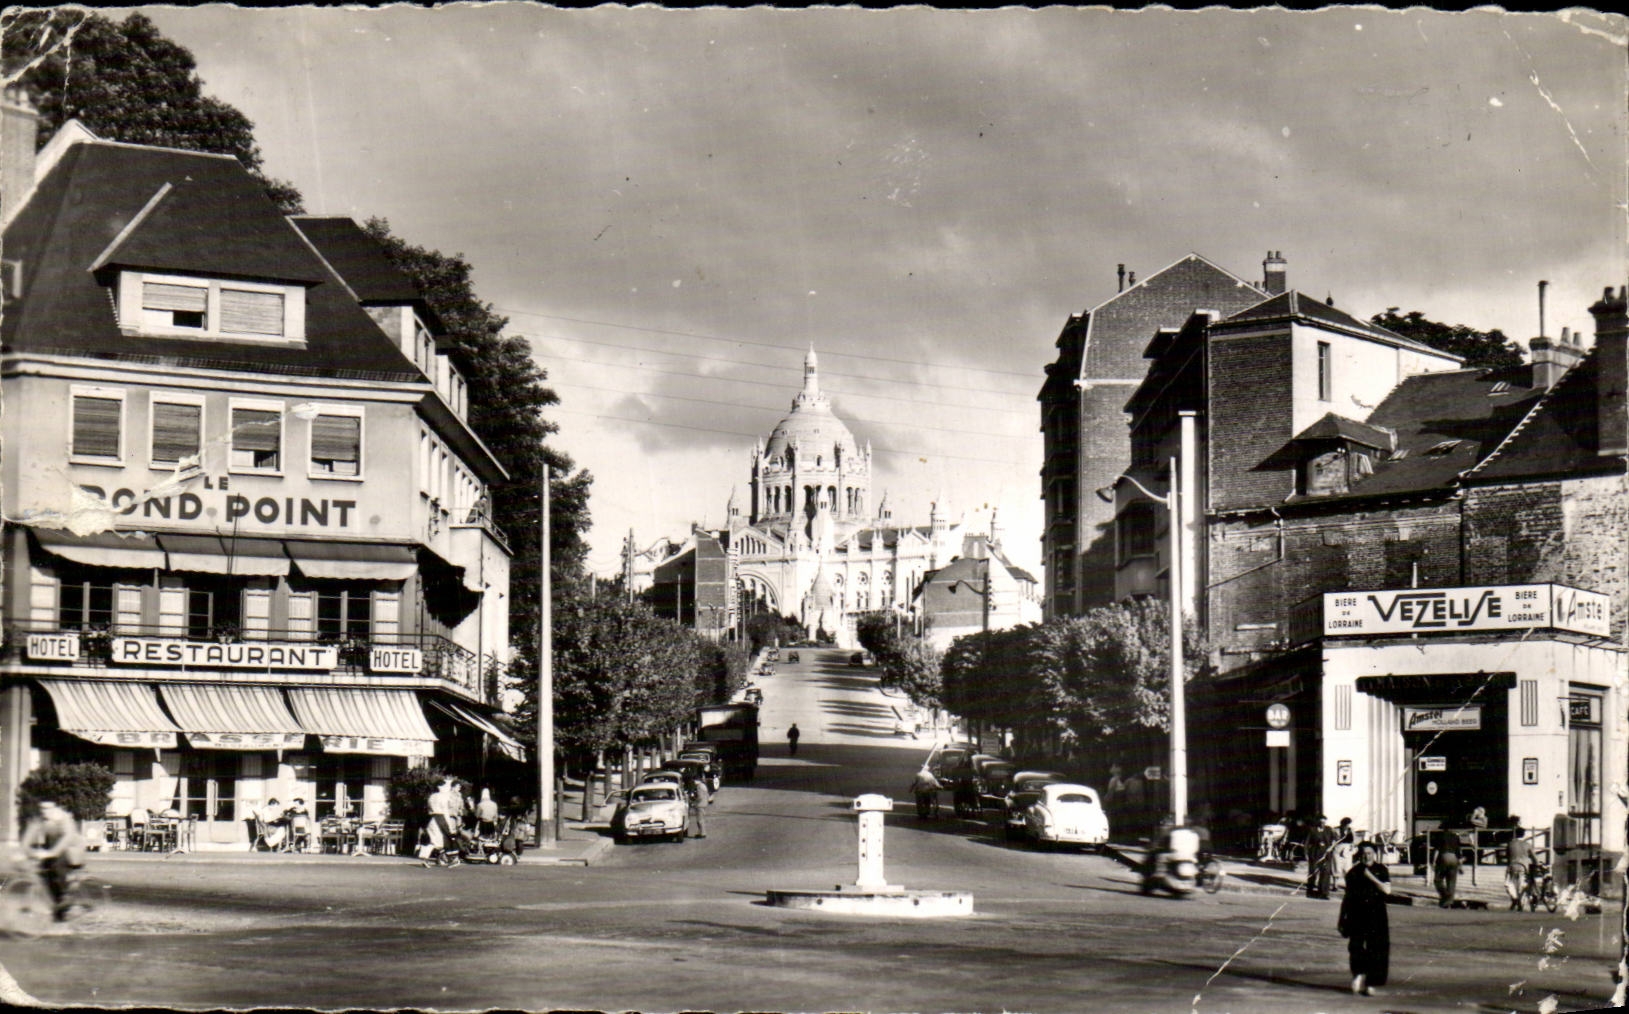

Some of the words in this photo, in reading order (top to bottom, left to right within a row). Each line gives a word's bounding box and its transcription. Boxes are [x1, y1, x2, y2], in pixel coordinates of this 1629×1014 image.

[204, 476, 229, 491] LE
[226, 495, 356, 527] POINT
[1367, 590, 1501, 628] VEZELISE
[1507, 612, 1545, 623] LORRAINE
[1328, 619, 1363, 629] LORRAINE
[30, 638, 75, 657] HOTEL
[123, 640, 327, 666] RESTAURANT
[373, 651, 419, 669] HOTEL
[1408, 710, 1443, 730] Amstel
